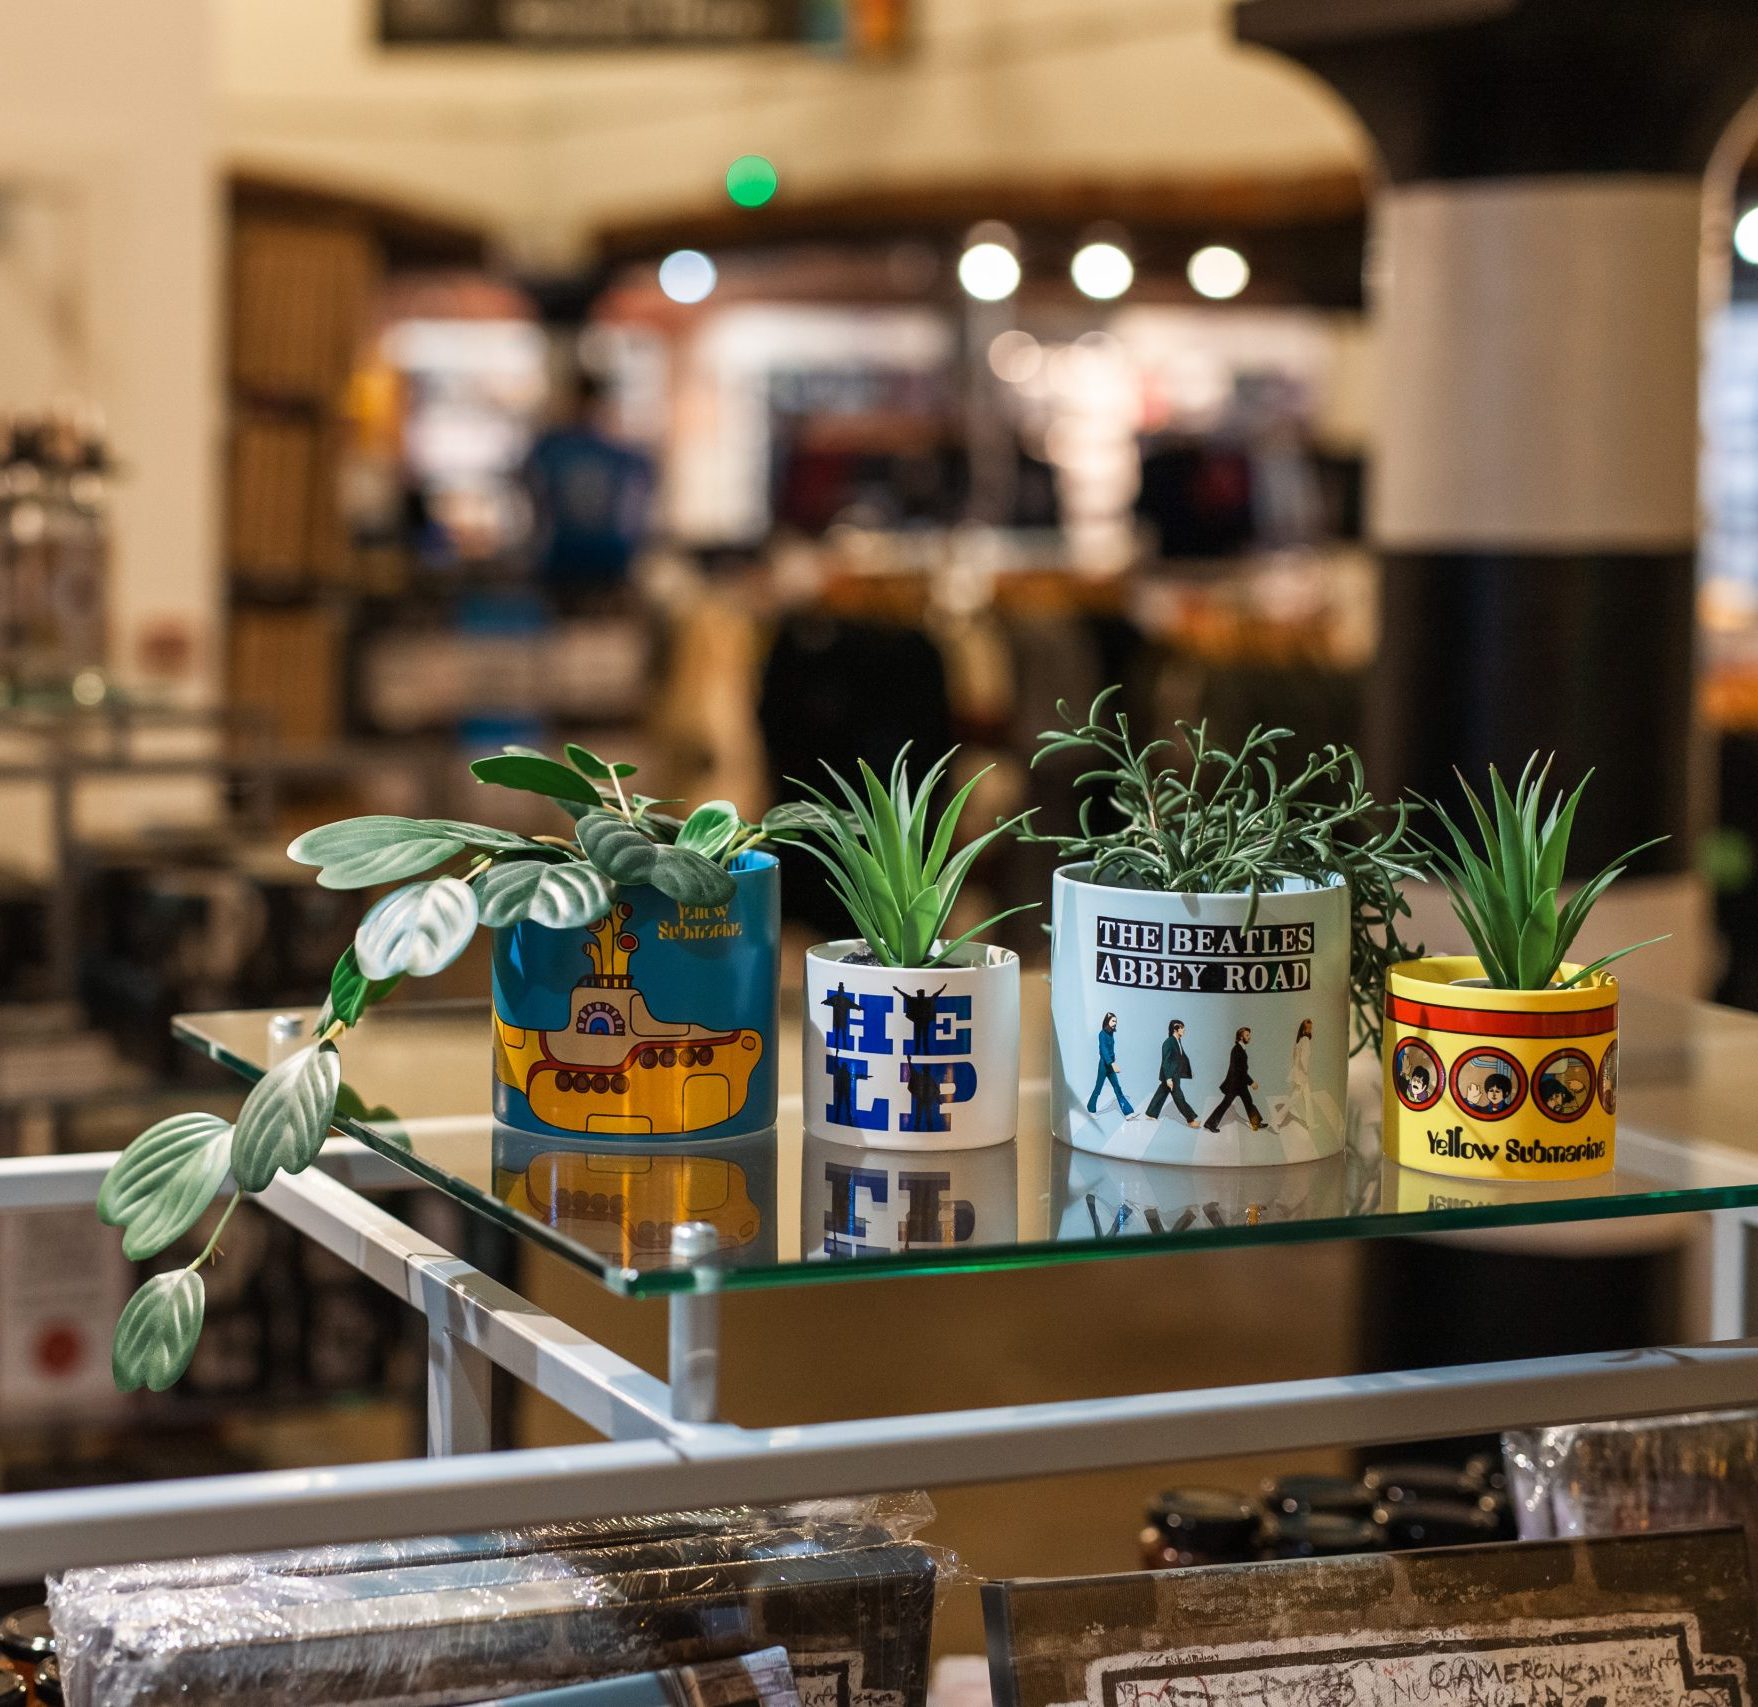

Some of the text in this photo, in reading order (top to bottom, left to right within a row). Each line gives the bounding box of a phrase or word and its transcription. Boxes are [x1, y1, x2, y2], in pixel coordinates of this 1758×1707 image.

[1099, 919, 1313, 954] THE BEATLES
[1098, 955, 1309, 992] ABBEY ROAD
[1426, 1126, 1607, 1164] Yellow Submarine
